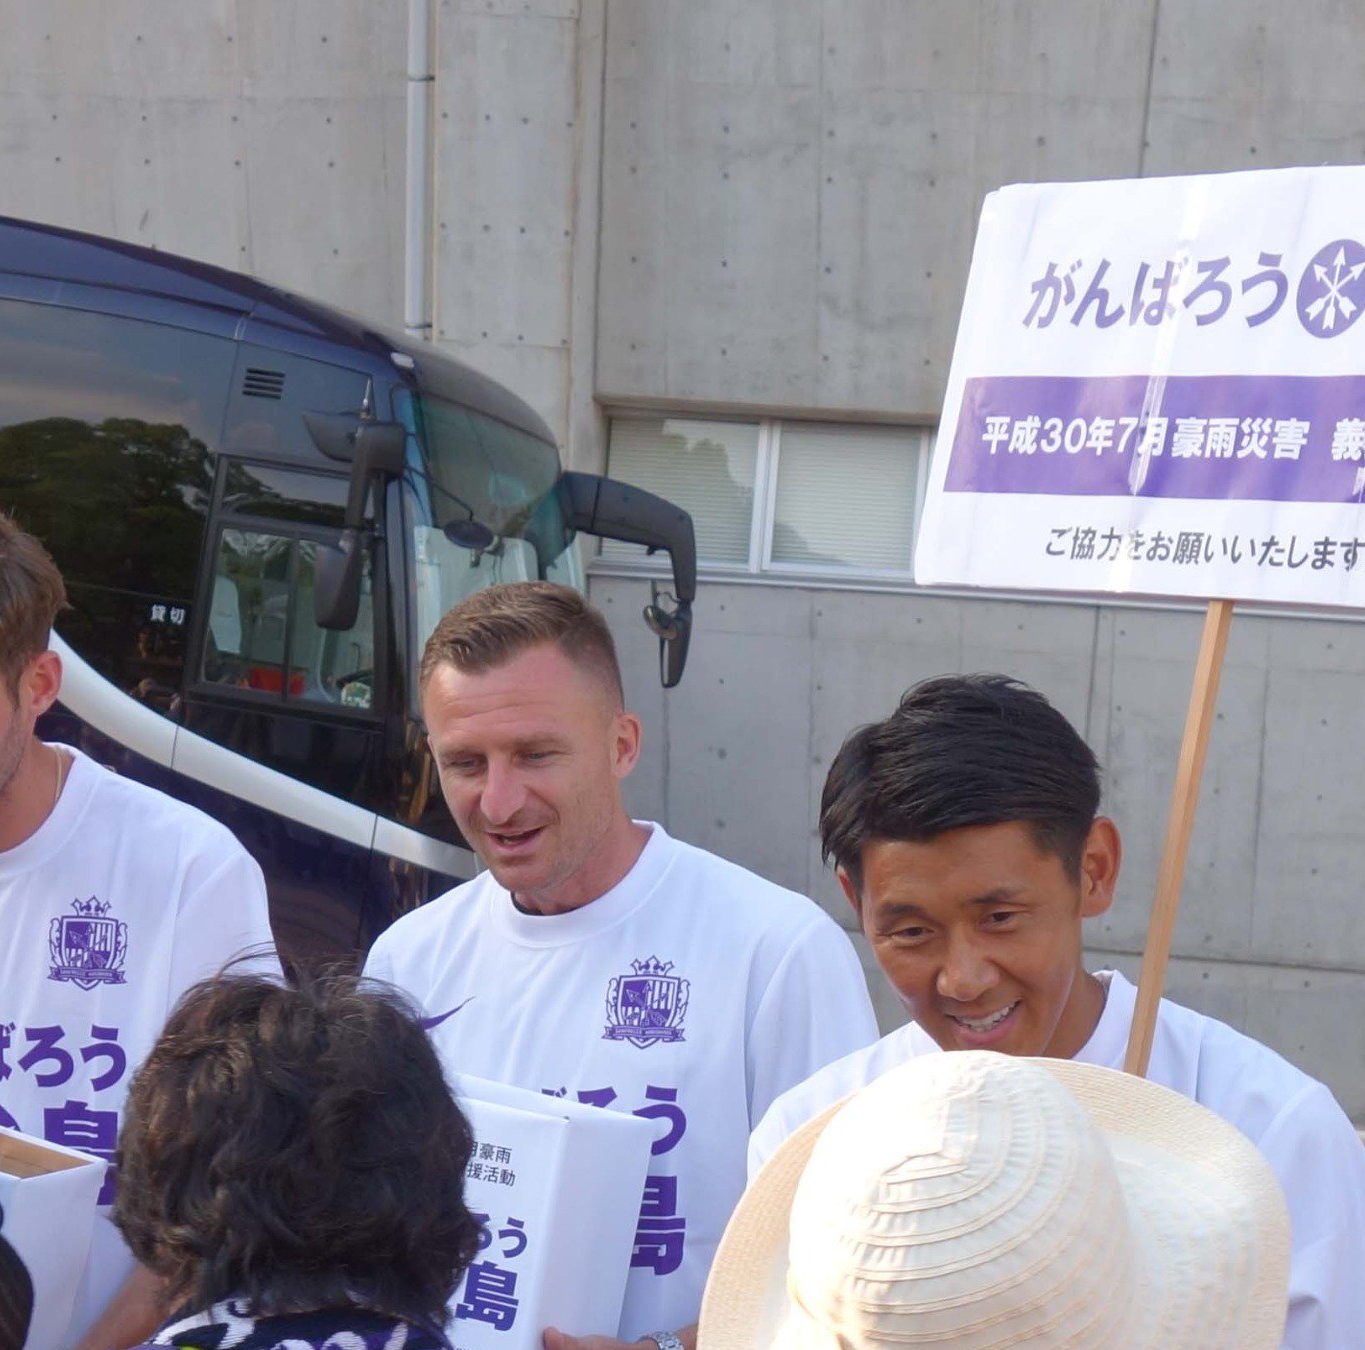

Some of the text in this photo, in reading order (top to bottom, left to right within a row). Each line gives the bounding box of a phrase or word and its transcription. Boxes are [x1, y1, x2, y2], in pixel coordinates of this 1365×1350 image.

[1022, 250, 1292, 329] がんばろう
[981, 416, 1308, 461] 平成30年7月豪雨災害
[455, 1260, 519, 1331] 島
